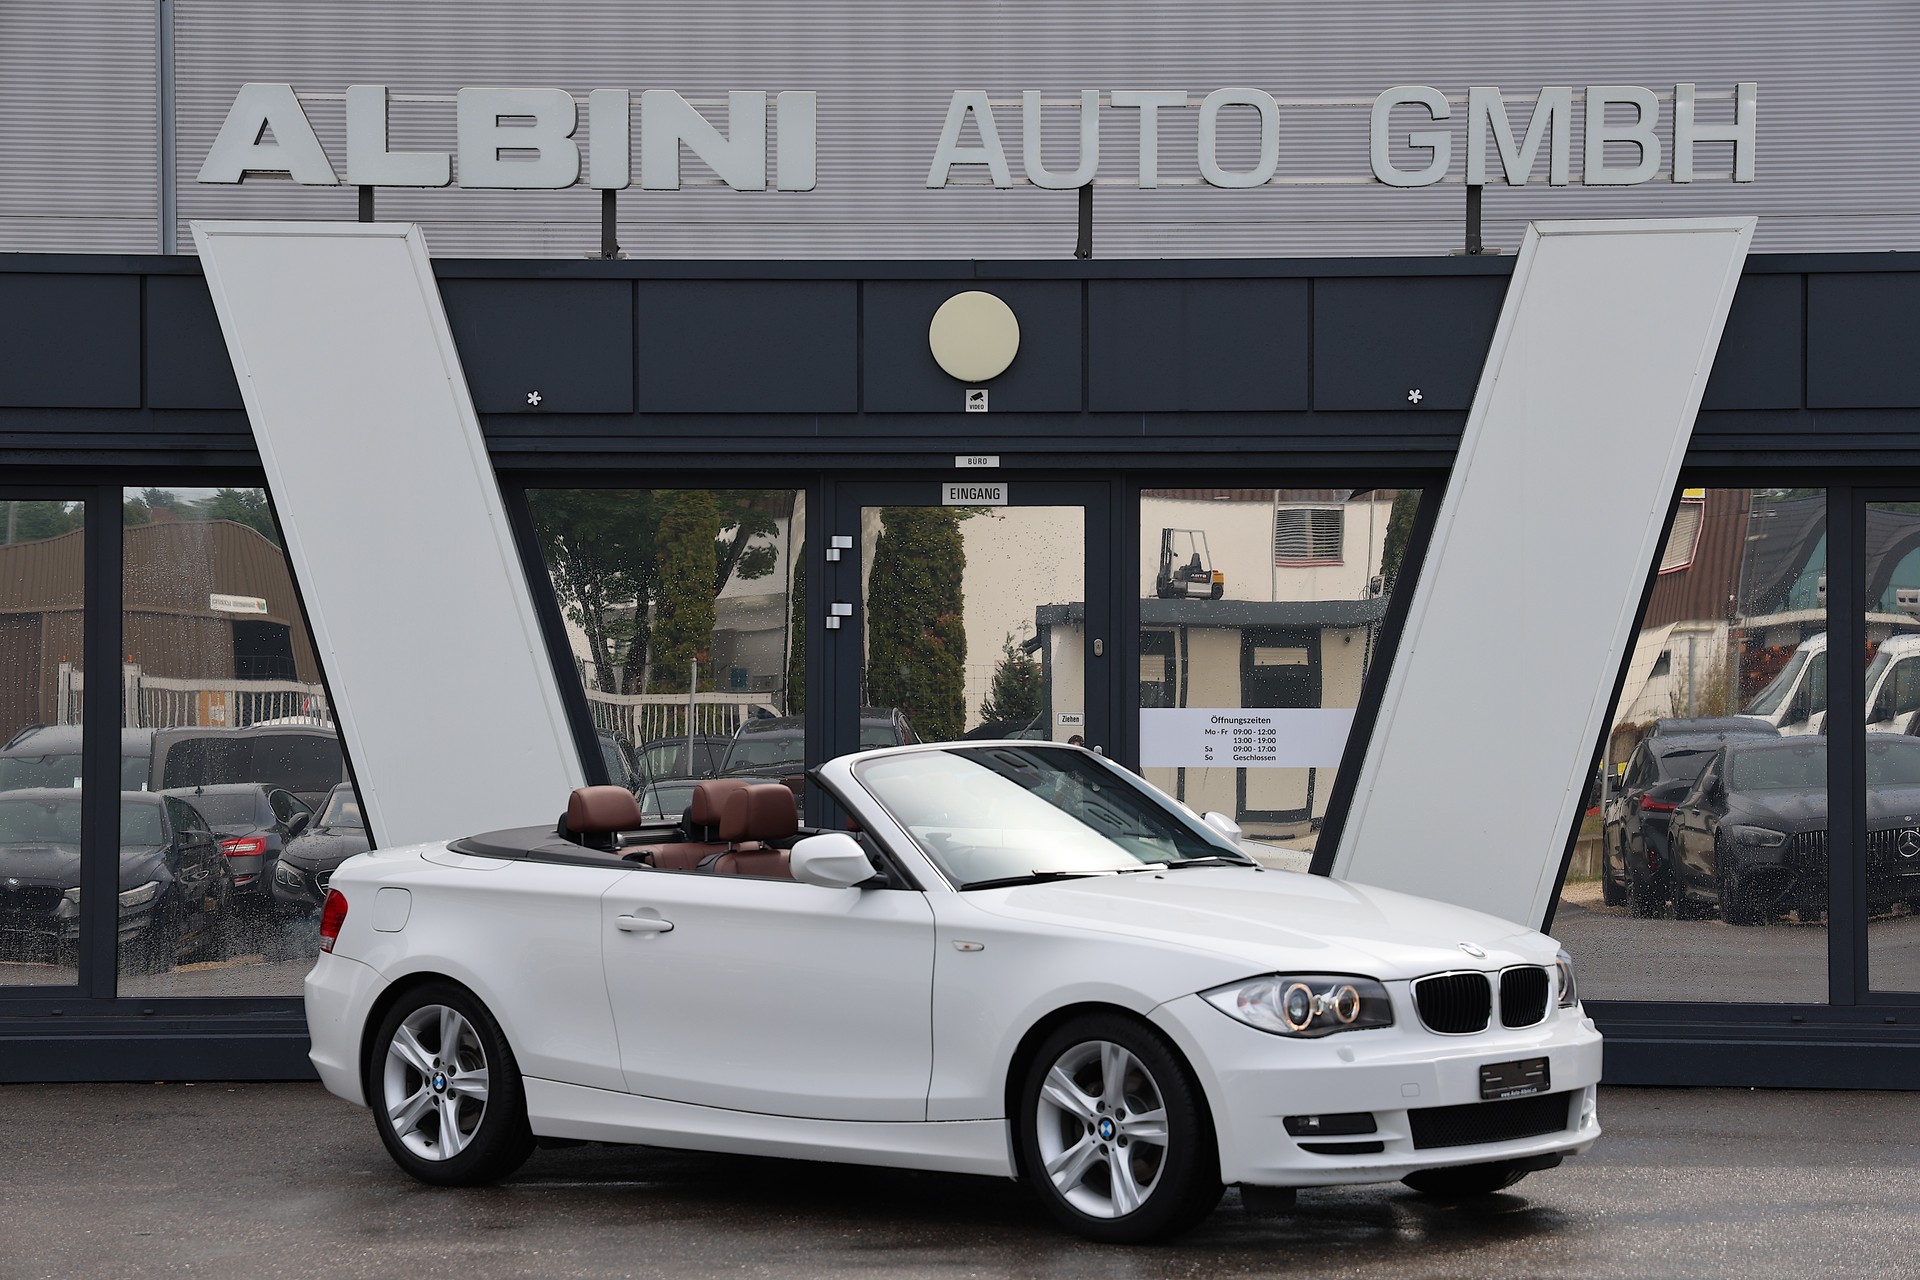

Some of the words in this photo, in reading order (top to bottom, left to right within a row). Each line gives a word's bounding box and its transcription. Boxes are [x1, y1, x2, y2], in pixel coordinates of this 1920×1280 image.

[196, 83, 817, 191] ALBINI
[926, 87, 1280, 189] AUTO
[1368, 82, 1757, 188] GMBH
[967, 456, 988, 465] BÜRO
[950, 487, 1001, 500] EINGANG
[1061, 715, 1080, 723] Ziehen
[1210, 715, 1271, 725] Öffnungszeiten
